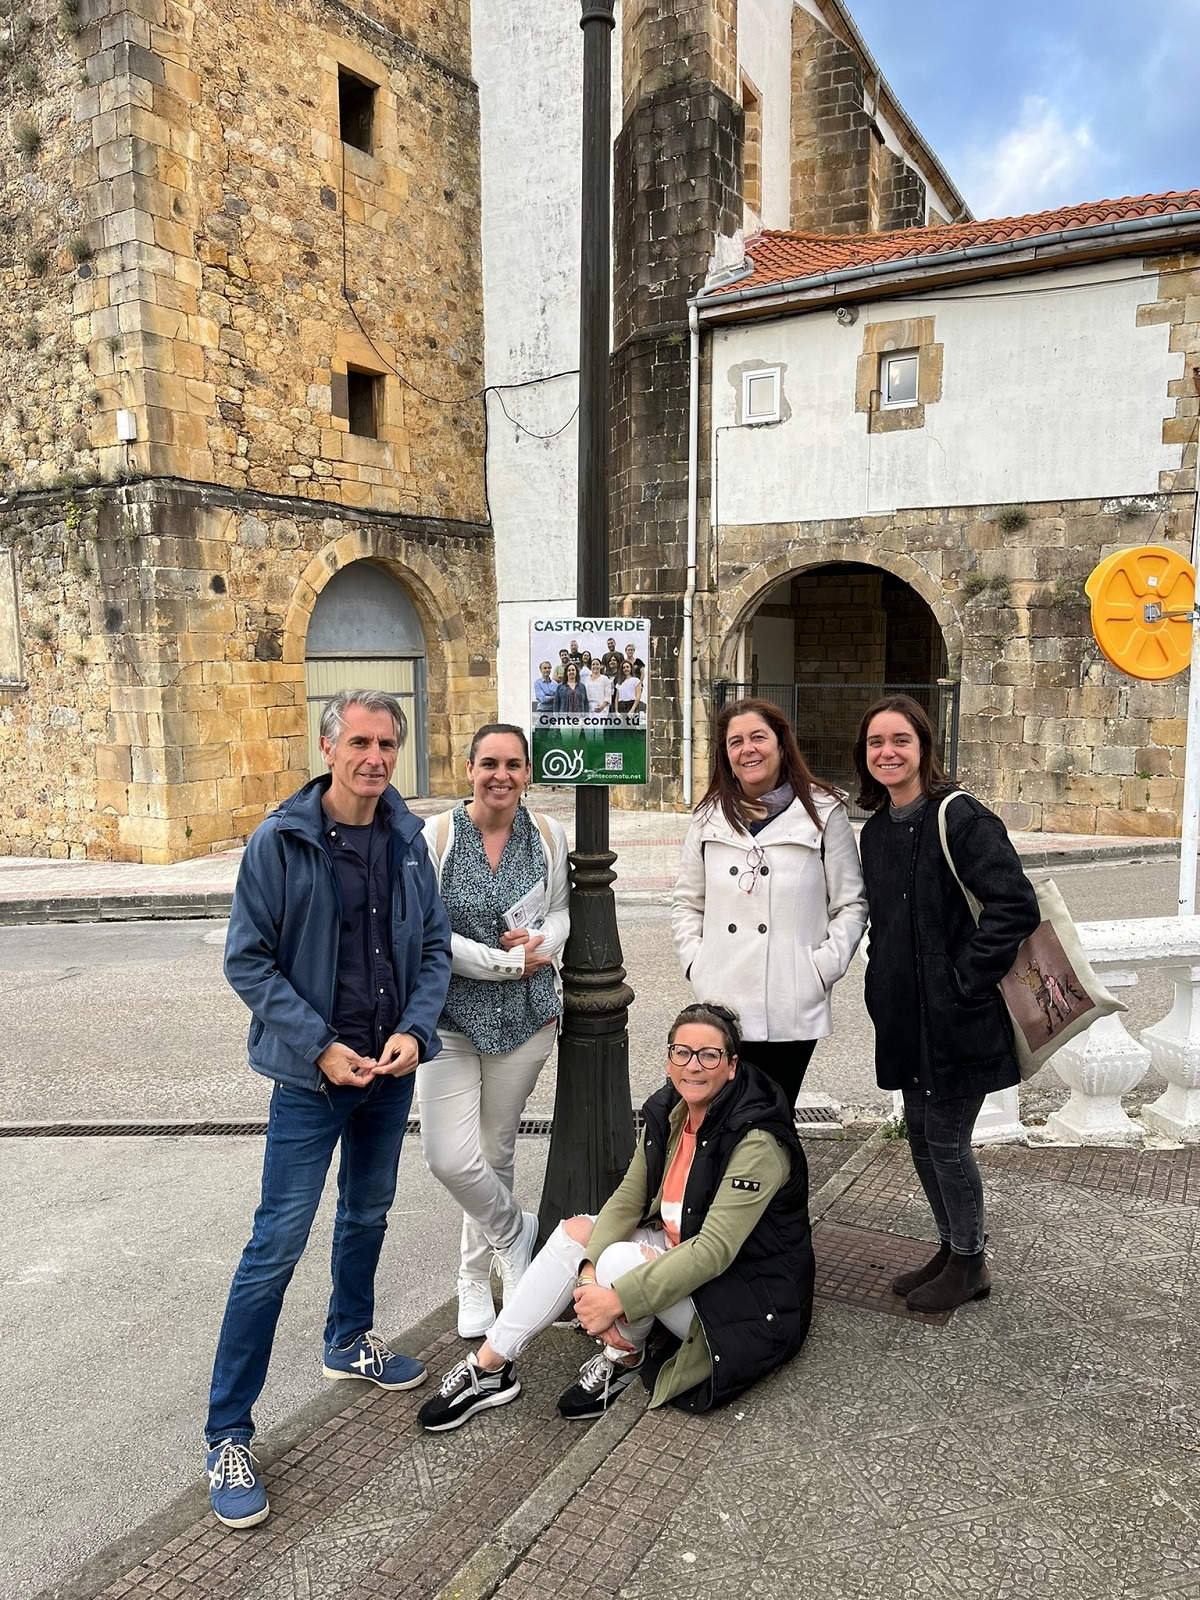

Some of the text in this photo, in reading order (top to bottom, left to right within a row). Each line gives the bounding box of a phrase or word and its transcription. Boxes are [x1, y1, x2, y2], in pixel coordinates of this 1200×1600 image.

[534, 620, 645, 632] CASTROVERDE
[540, 714, 640, 726] Gente como tú
